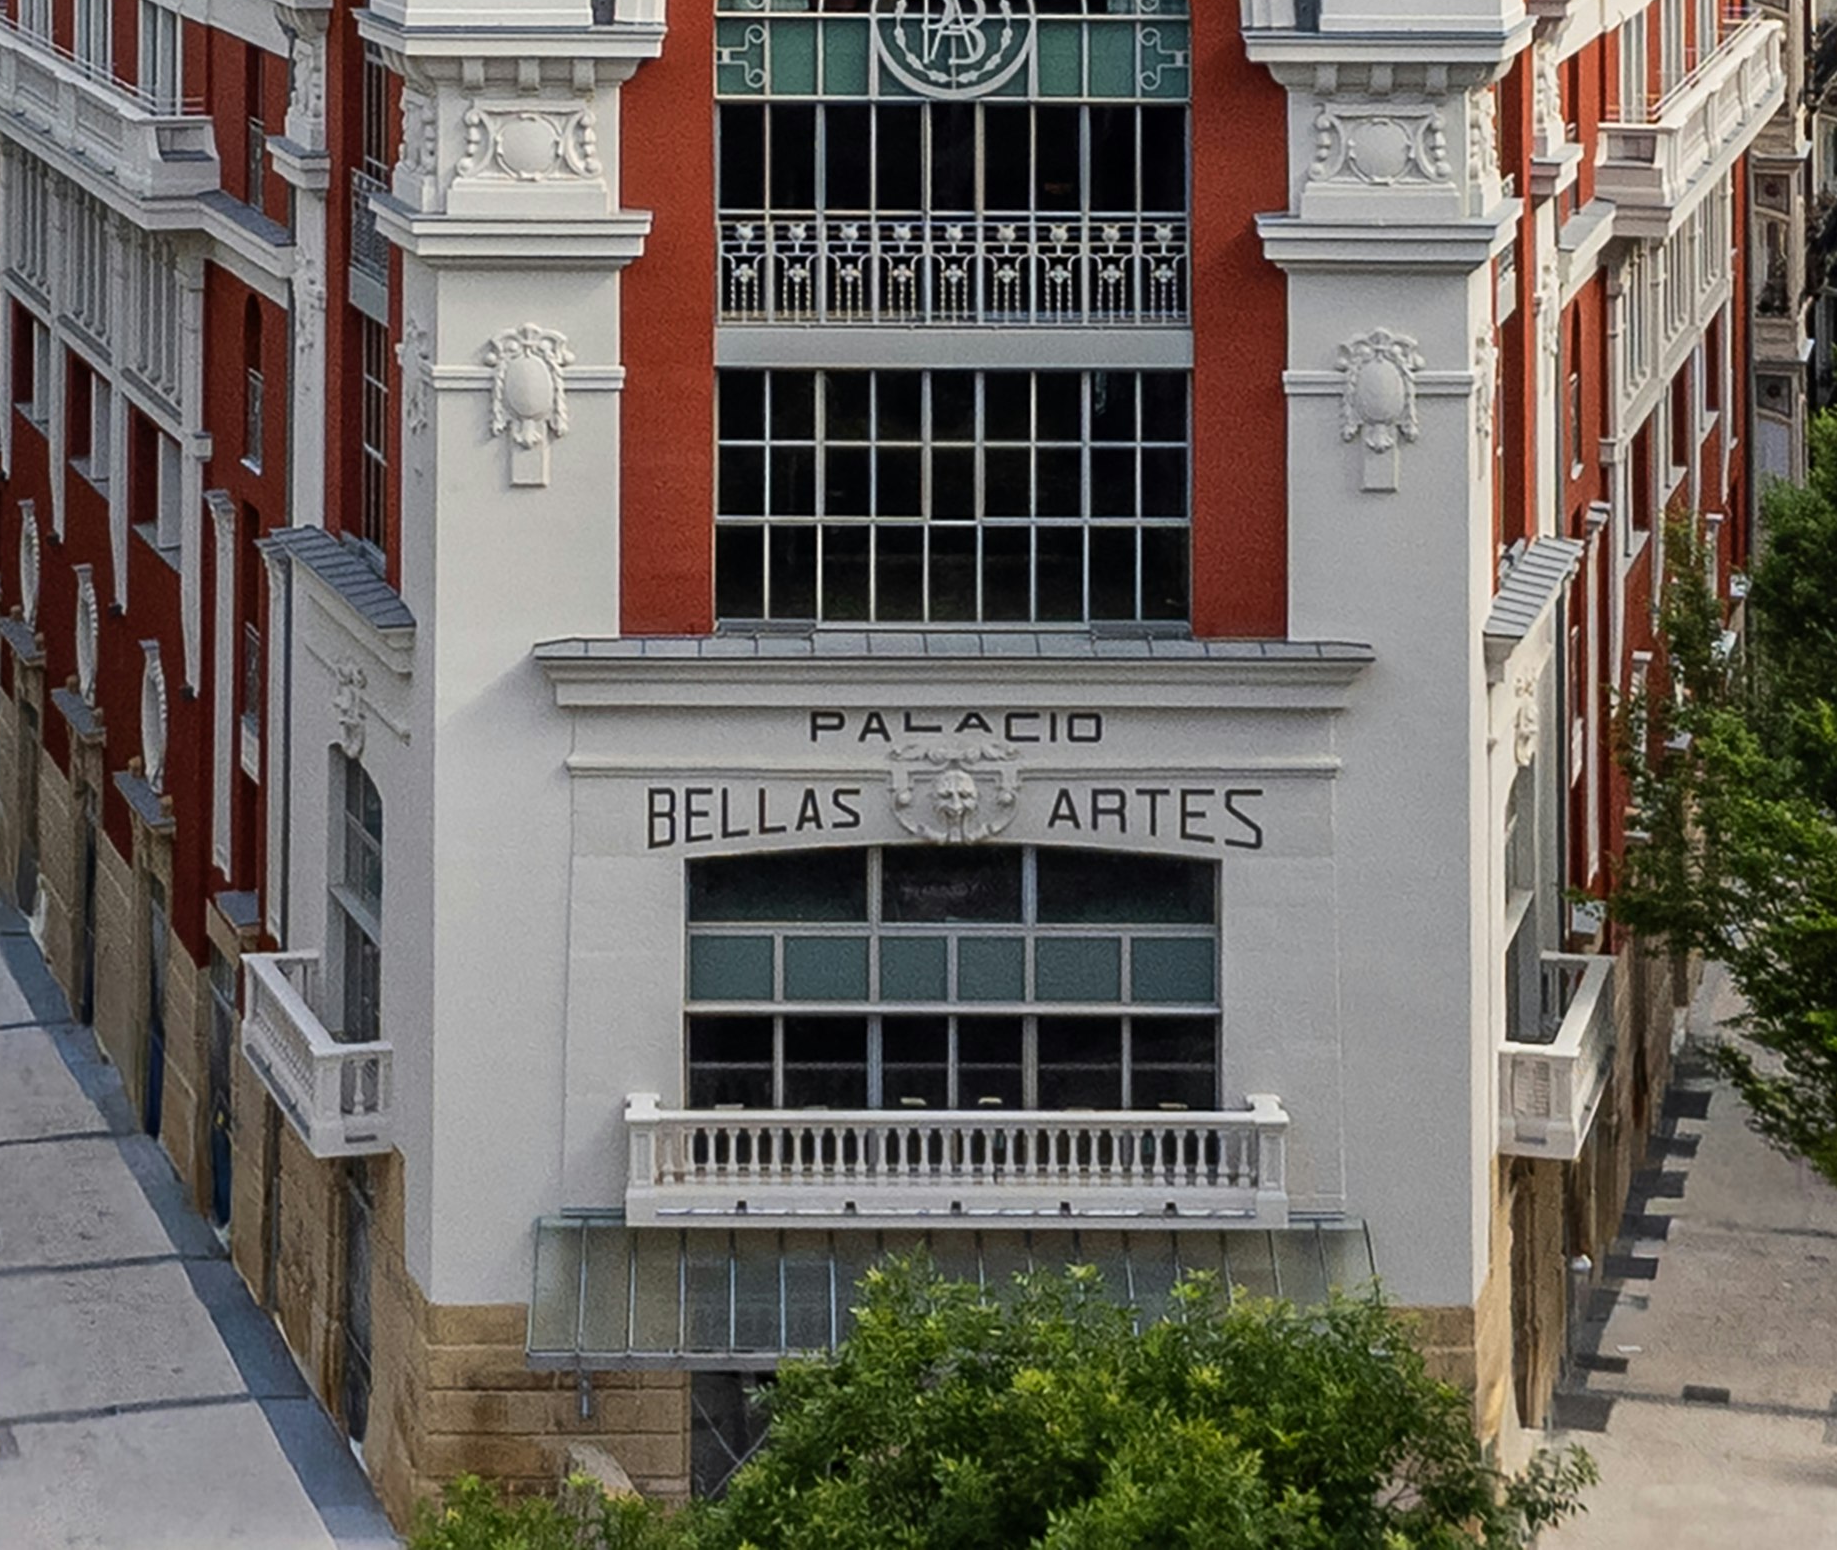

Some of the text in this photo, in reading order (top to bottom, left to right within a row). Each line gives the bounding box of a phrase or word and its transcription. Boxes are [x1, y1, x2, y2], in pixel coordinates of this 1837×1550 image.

[809, 711, 1103, 743] PALACIO
[647, 787, 1265, 850] BELLAS ARTES
